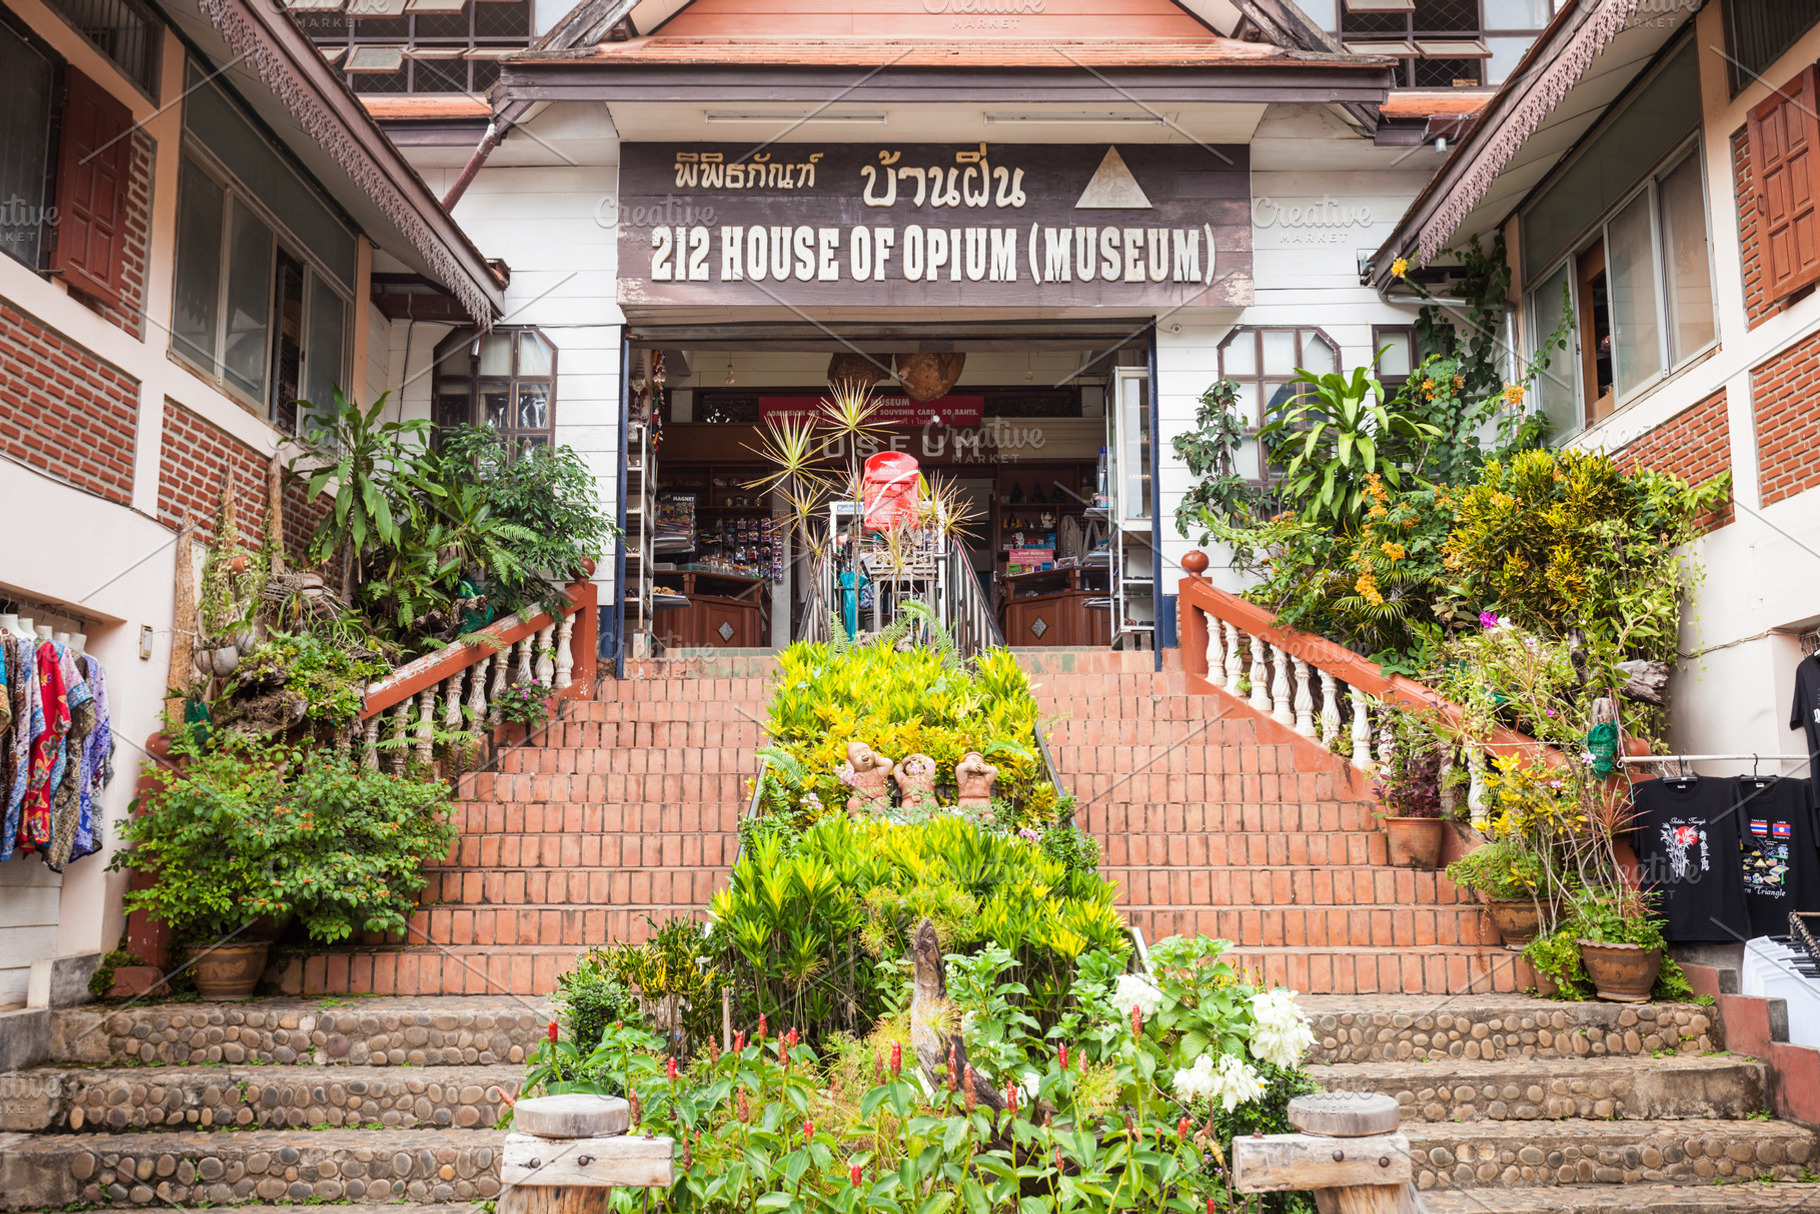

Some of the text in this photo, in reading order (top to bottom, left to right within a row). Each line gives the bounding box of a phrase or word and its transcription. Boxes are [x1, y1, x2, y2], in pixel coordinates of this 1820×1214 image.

[674, 141, 1027, 209] พิพิธภัณฑ์ บ้านฝิ่น
[651, 221, 1215, 286] 212 HOUSE OF OPIUM (MUSEUM)
[792, 435, 980, 457] USEUM
[1754, 886, 1786, 899] Triangle
